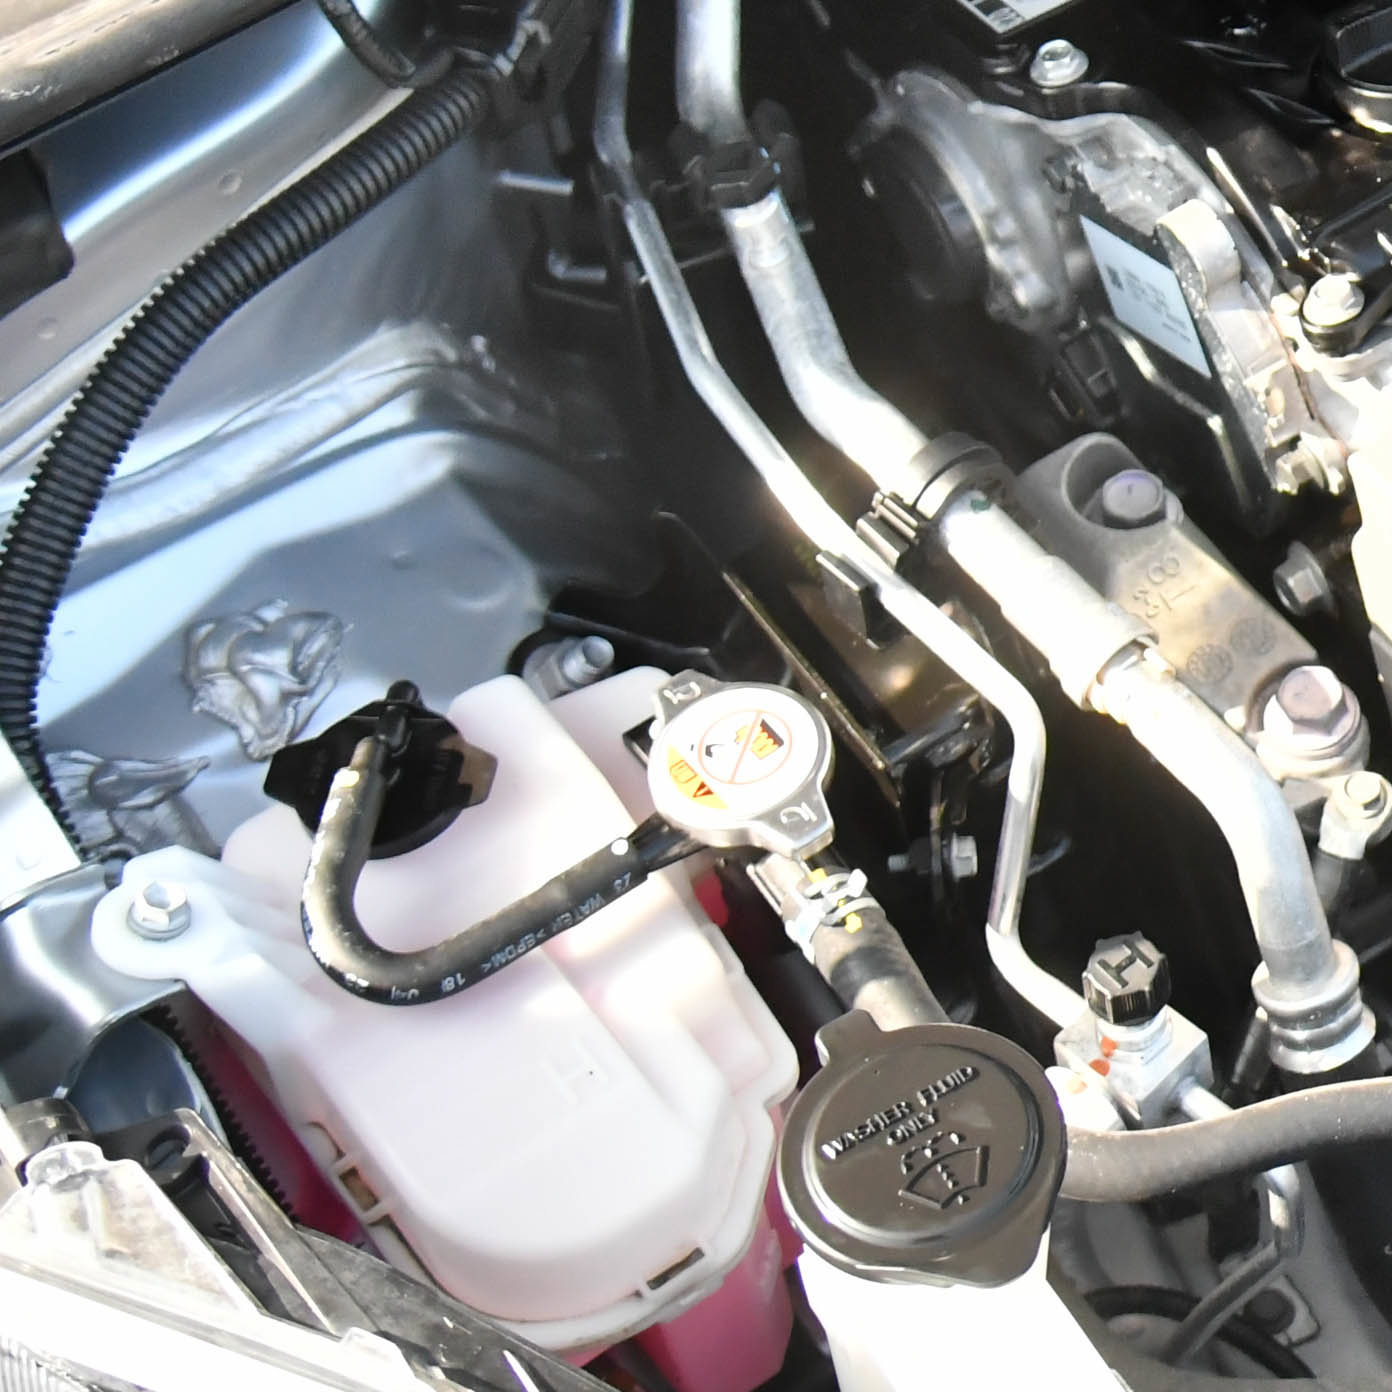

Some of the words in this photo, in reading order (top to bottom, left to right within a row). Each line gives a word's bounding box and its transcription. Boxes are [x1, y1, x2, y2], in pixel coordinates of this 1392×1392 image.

[1097, 939, 1154, 989] H
[822, 1100, 911, 1159] WASHER
[916, 1065, 980, 1107] FLUID
[887, 1108, 938, 1146] ONLY
